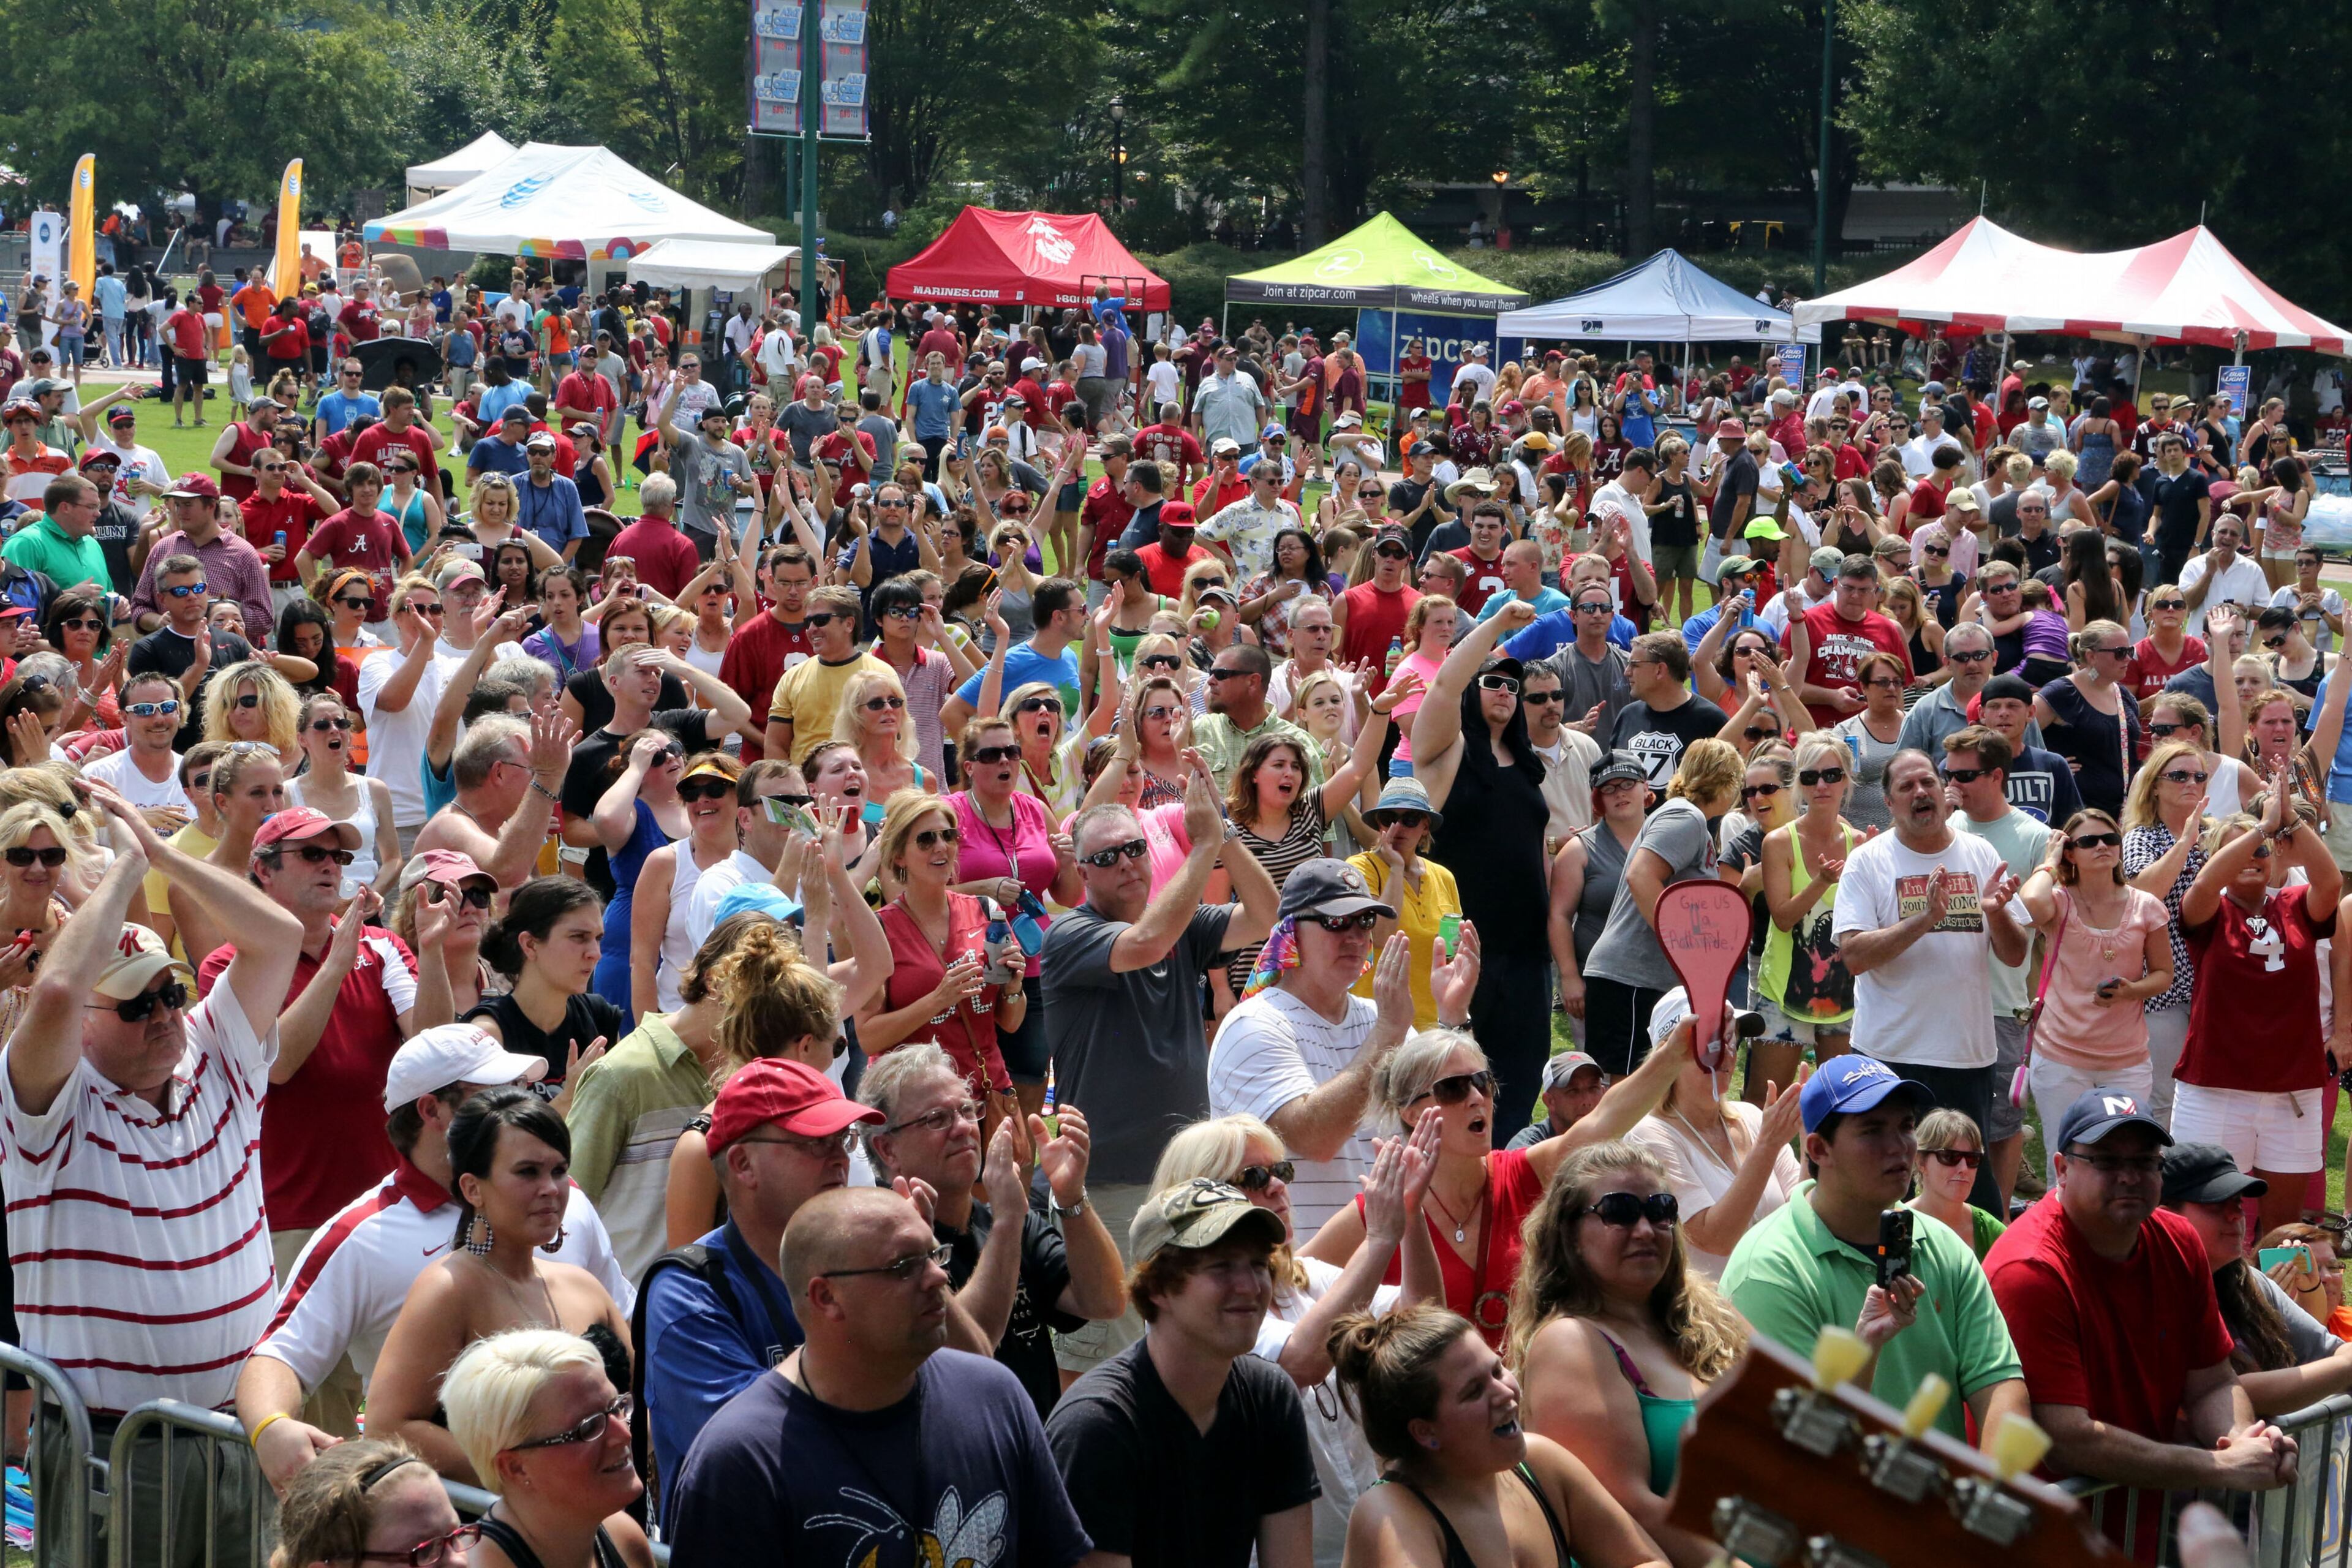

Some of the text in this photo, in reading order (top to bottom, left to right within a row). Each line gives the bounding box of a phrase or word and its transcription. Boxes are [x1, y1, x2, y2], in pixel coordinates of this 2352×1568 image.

[913, 285, 1000, 298] MARINES.COM
[1262, 284, 1356, 301] Join at zipcar.com
[1411, 292, 1439, 304] wheels
[1441, 294, 1461, 307] when
[1463, 298, 1477, 309] you
[1478, 298, 1496, 309] want
[1399, 328, 1490, 363] zipcar
[2326, 429, 2346, 443] 22
[1597, 448, 1621, 472] A
[349, 533, 367, 552] A
[460, 562, 473, 573] A
[1635, 737, 1673, 751] BLACK
[2005, 779, 2048, 803] UILT
[1902, 881, 1924, 895] I'm
[1680, 895, 1708, 910] Give
[1947, 895, 1978, 911] RONG
[2249, 926, 2285, 973] 4
[2102, 1096, 2138, 1115] N
